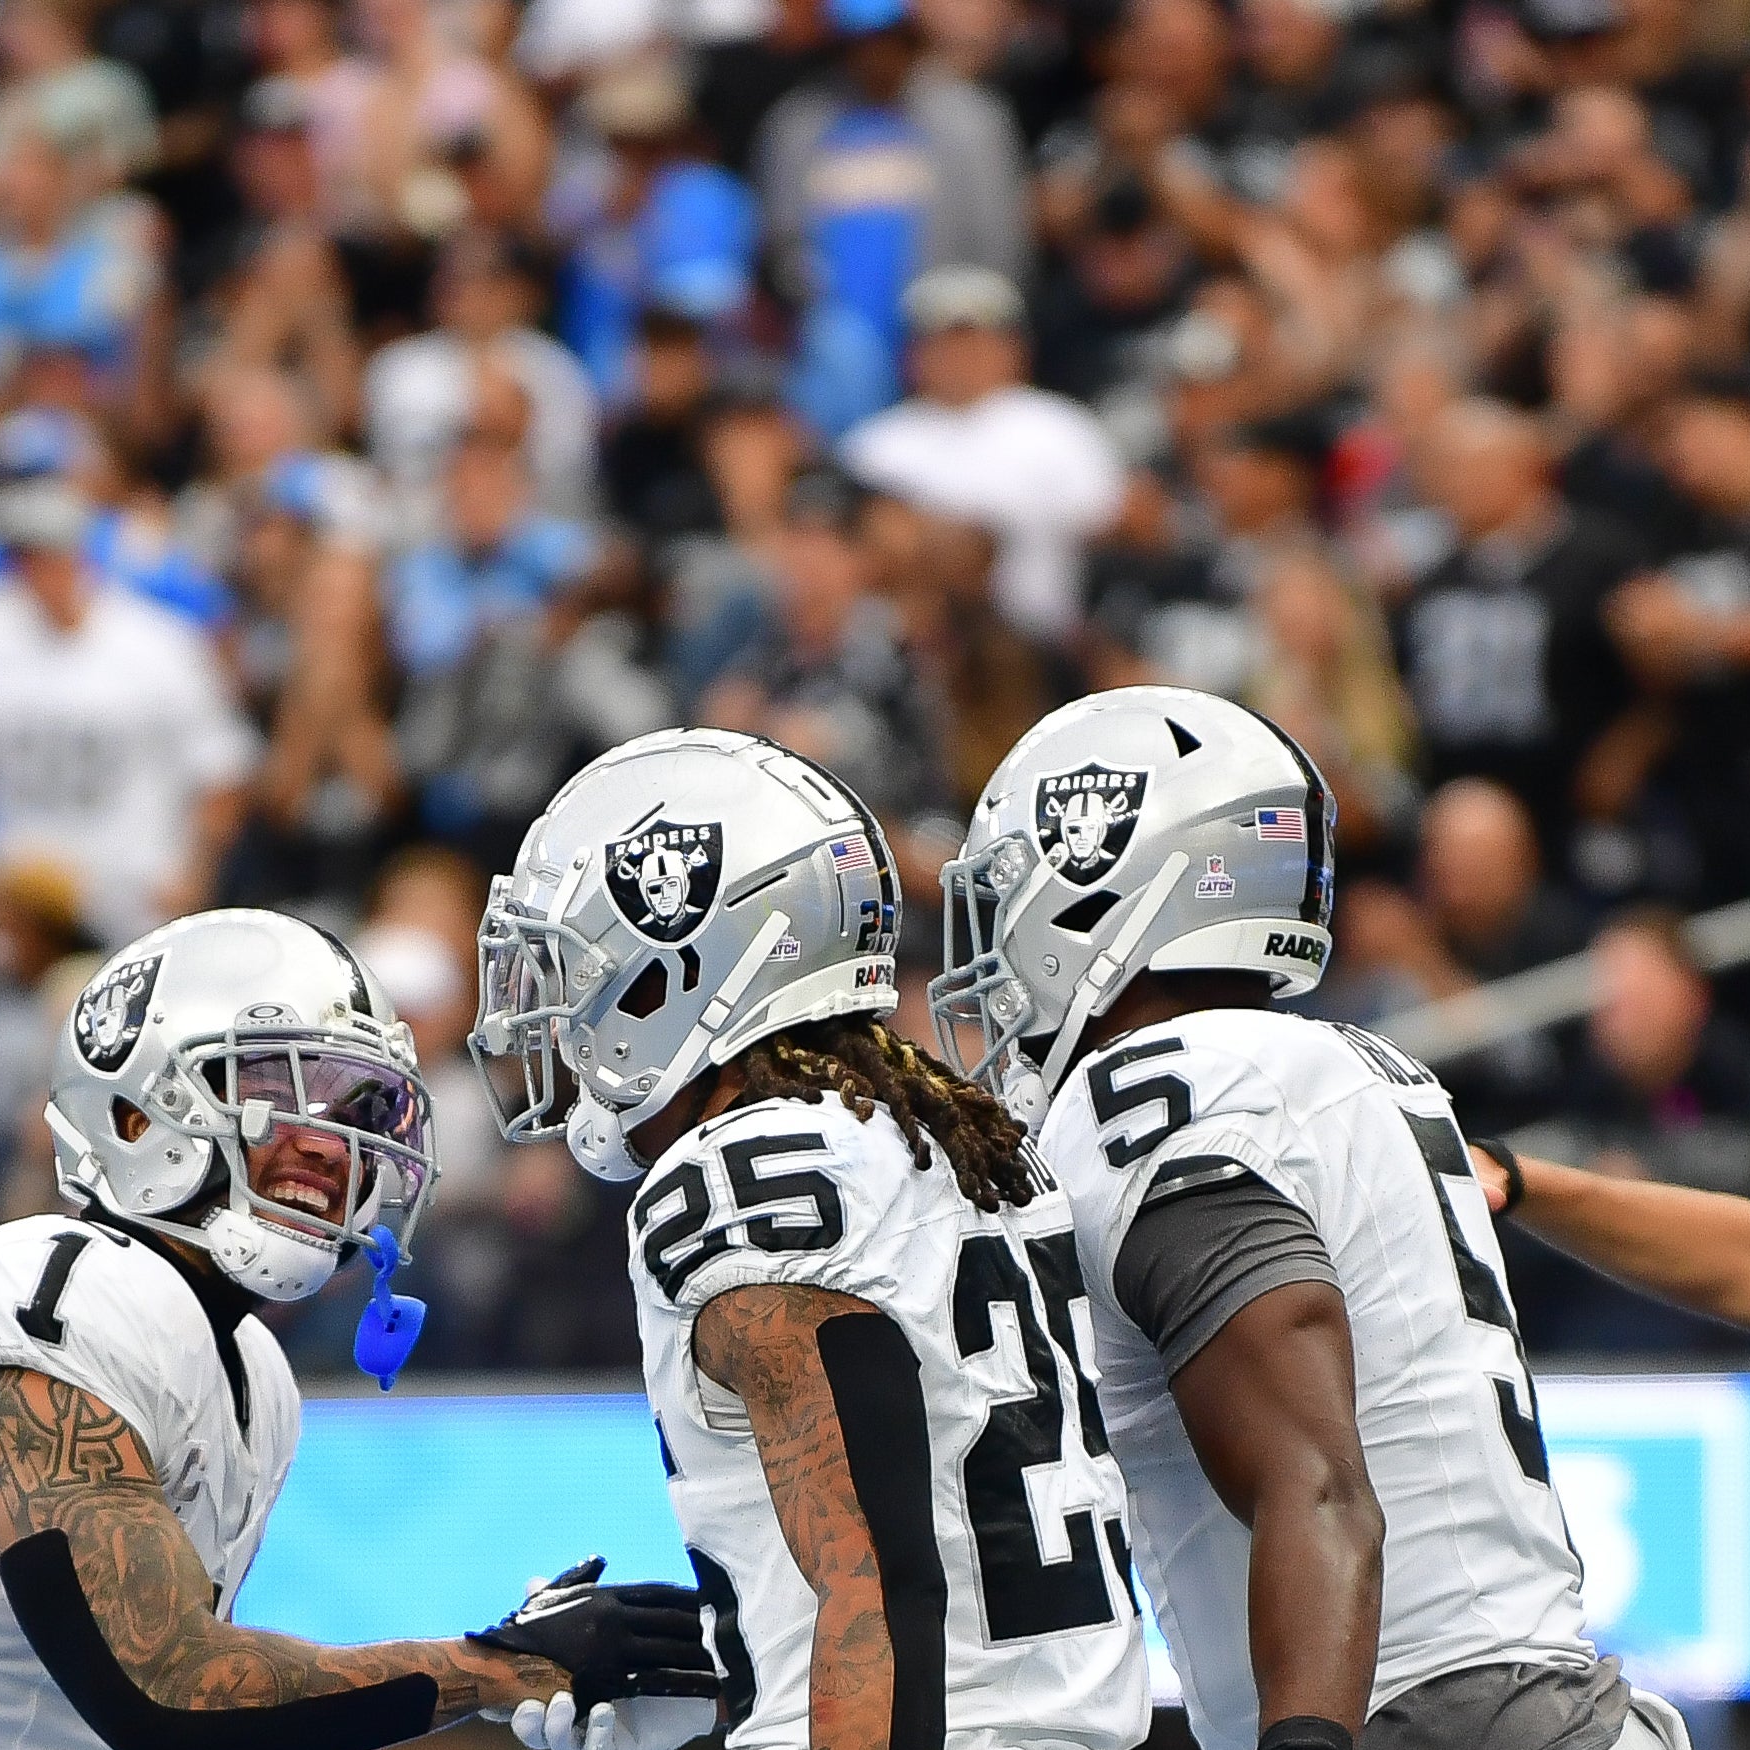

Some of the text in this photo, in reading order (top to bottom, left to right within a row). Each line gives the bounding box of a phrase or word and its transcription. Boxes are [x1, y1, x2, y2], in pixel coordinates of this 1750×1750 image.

[1045, 773, 1138, 793] RAIDERS
[1085, 1036, 1194, 1171] 5
[637, 1132, 844, 1304] 25
[16, 1231, 91, 1344] 1
